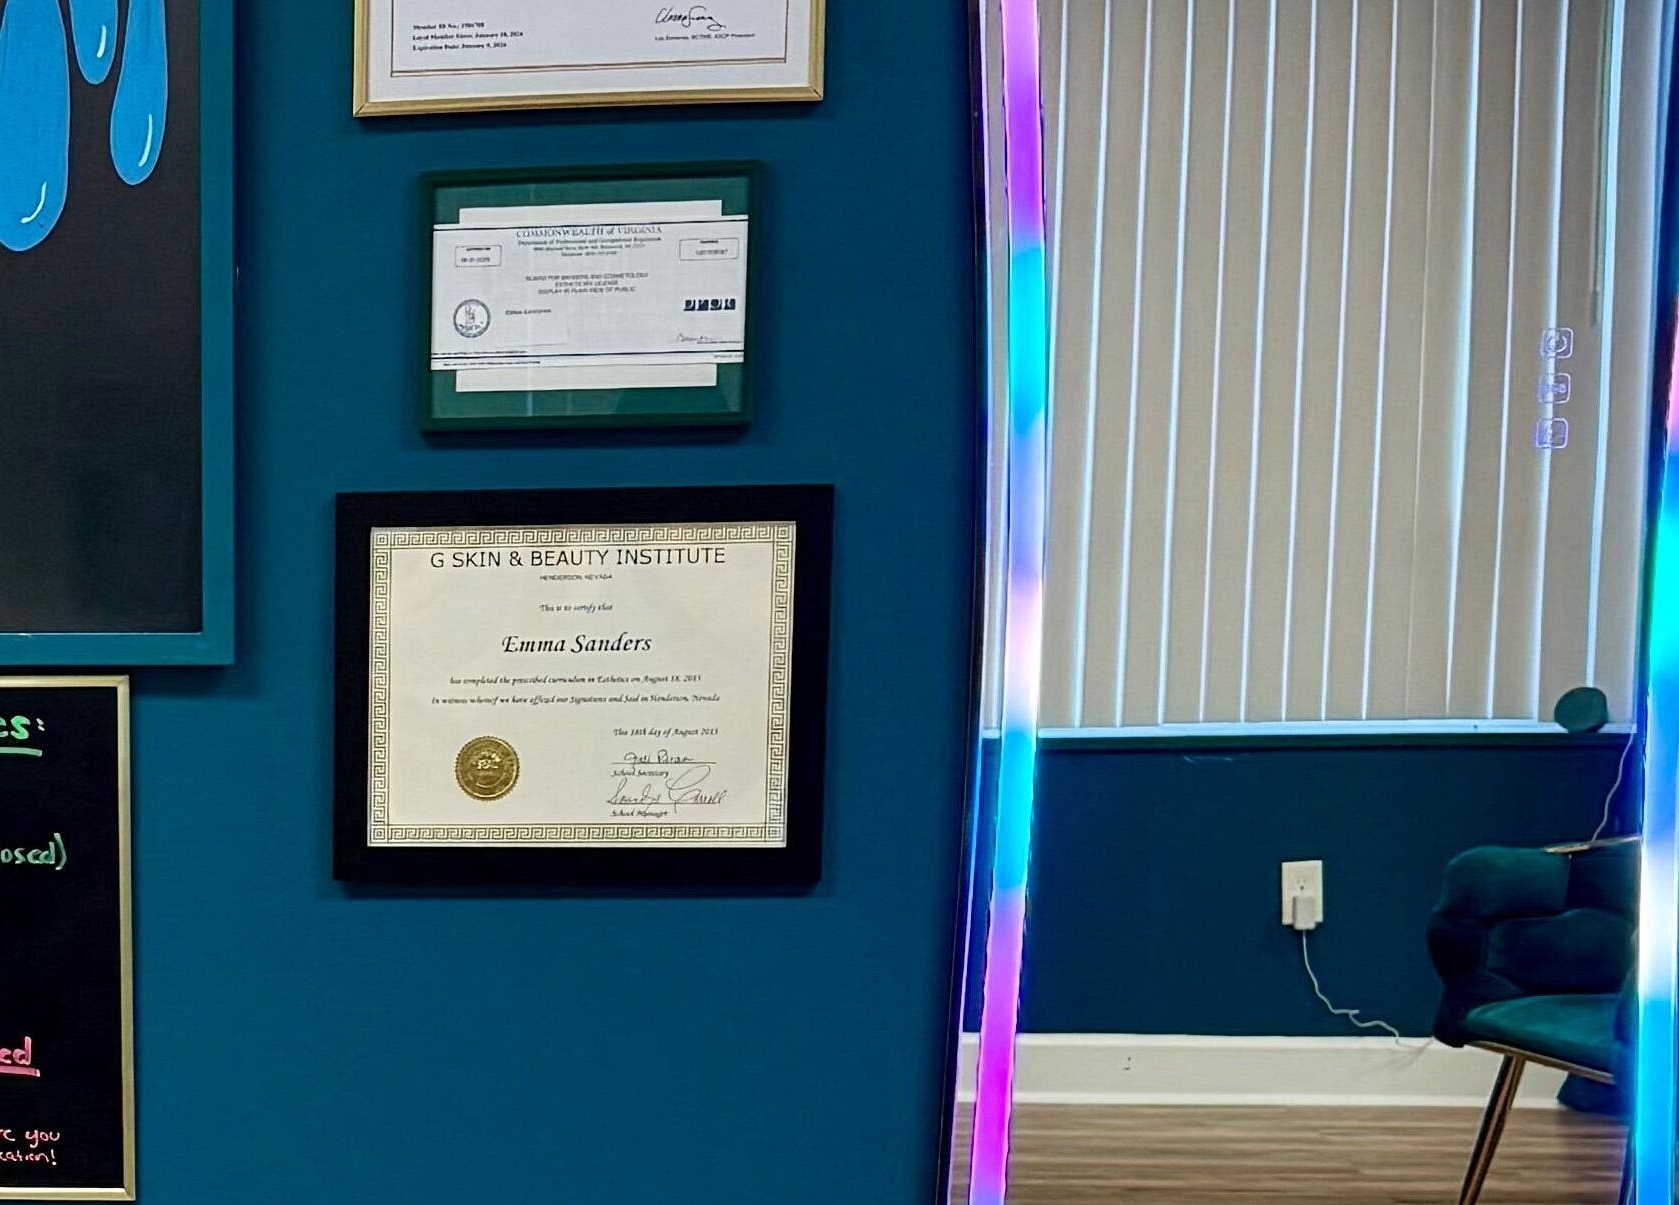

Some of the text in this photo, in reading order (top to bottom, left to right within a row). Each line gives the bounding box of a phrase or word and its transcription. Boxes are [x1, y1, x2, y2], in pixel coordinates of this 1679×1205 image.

[430, 548, 726, 568] G SKIN & BEAUTY INSTITUTE
[501, 631, 652, 653] Emma Sanders
[24, 1130, 60, 1147] you
